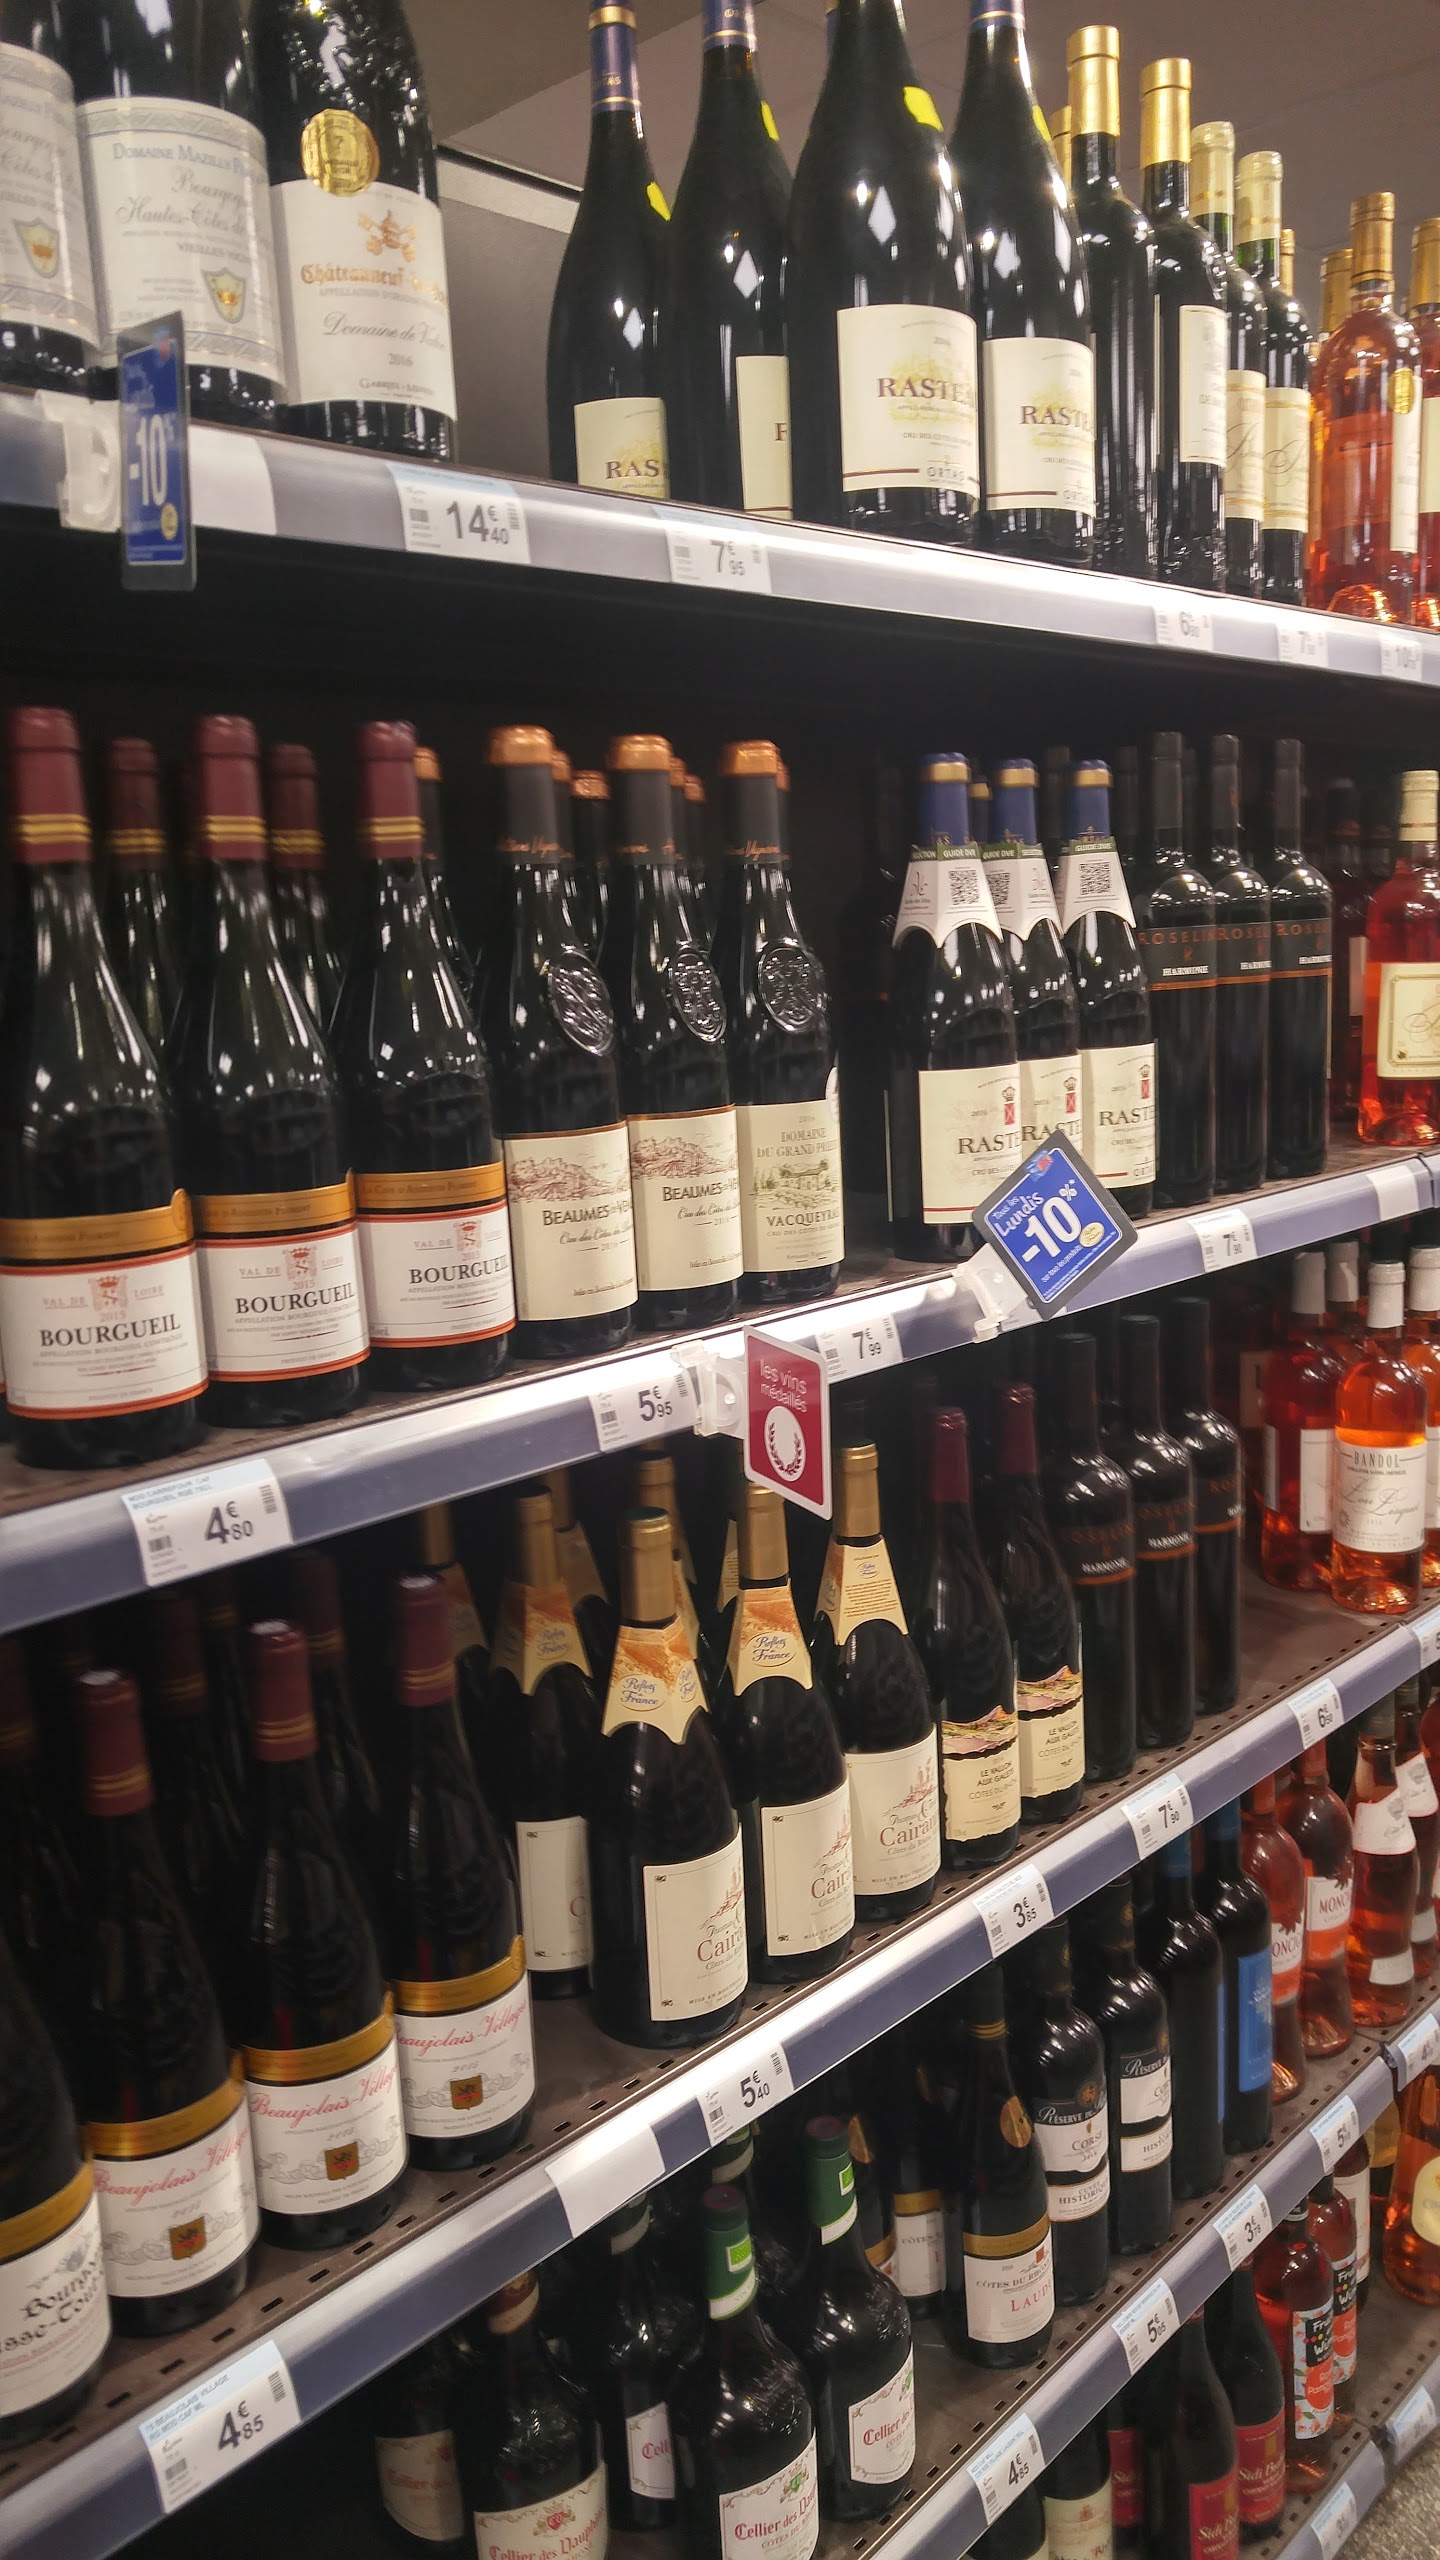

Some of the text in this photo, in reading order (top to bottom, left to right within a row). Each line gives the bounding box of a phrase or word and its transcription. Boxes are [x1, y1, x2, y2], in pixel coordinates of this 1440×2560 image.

[322, 311, 398, 337] Domaine
[776, 1142, 816, 1158] GRAND
[994, 1191, 1046, 1238] Lundis
[238, 1267, 261, 1277] VAL
[265, 1265, 281, 1276] DE
[235, 1282, 355, 1315] BOURGUEIL
[292, 1279, 315, 1292] 2015
[100, 1309, 127, 1323] 2015
[40, 1313, 181, 1347] BOURGUEIL
[850, 1331, 867, 1360] 7
[868, 1341, 883, 1357] 99
[761, 1359, 808, 1395] les vins
[638, 1390, 656, 1422] 5
[654, 1400, 673, 1418] 95
[760, 1383, 808, 1413] médaillés
[1354, 1451, 1401, 1468] BANDOL
[204, 1505, 231, 1545] 4
[231, 1520, 255, 1541] 80
[752, 1649, 792, 1662] France
[754, 1635, 788, 1650] Reflets
[622, 1677, 657, 1693] Reflets
[620, 1691, 660, 1706] France
[1157, 1804, 1169, 1830] 7
[1013, 1902, 1027, 1929] 3
[739, 2076, 756, 2109] 5
[756, 2082, 771, 2101] 40
[1036, 2105, 1082, 2124] RÉSERVE
[1244, 2221, 1254, 2243] 3
[976, 2275, 1027, 2290] CÔTES DU
[1147, 2319, 1158, 2345] 5
[217, 2411, 241, 2451] 4
[242, 2414, 266, 2440] 85
[1008, 2460, 1020, 2487] 4
[734, 2511, 798, 2542] Cellier des
